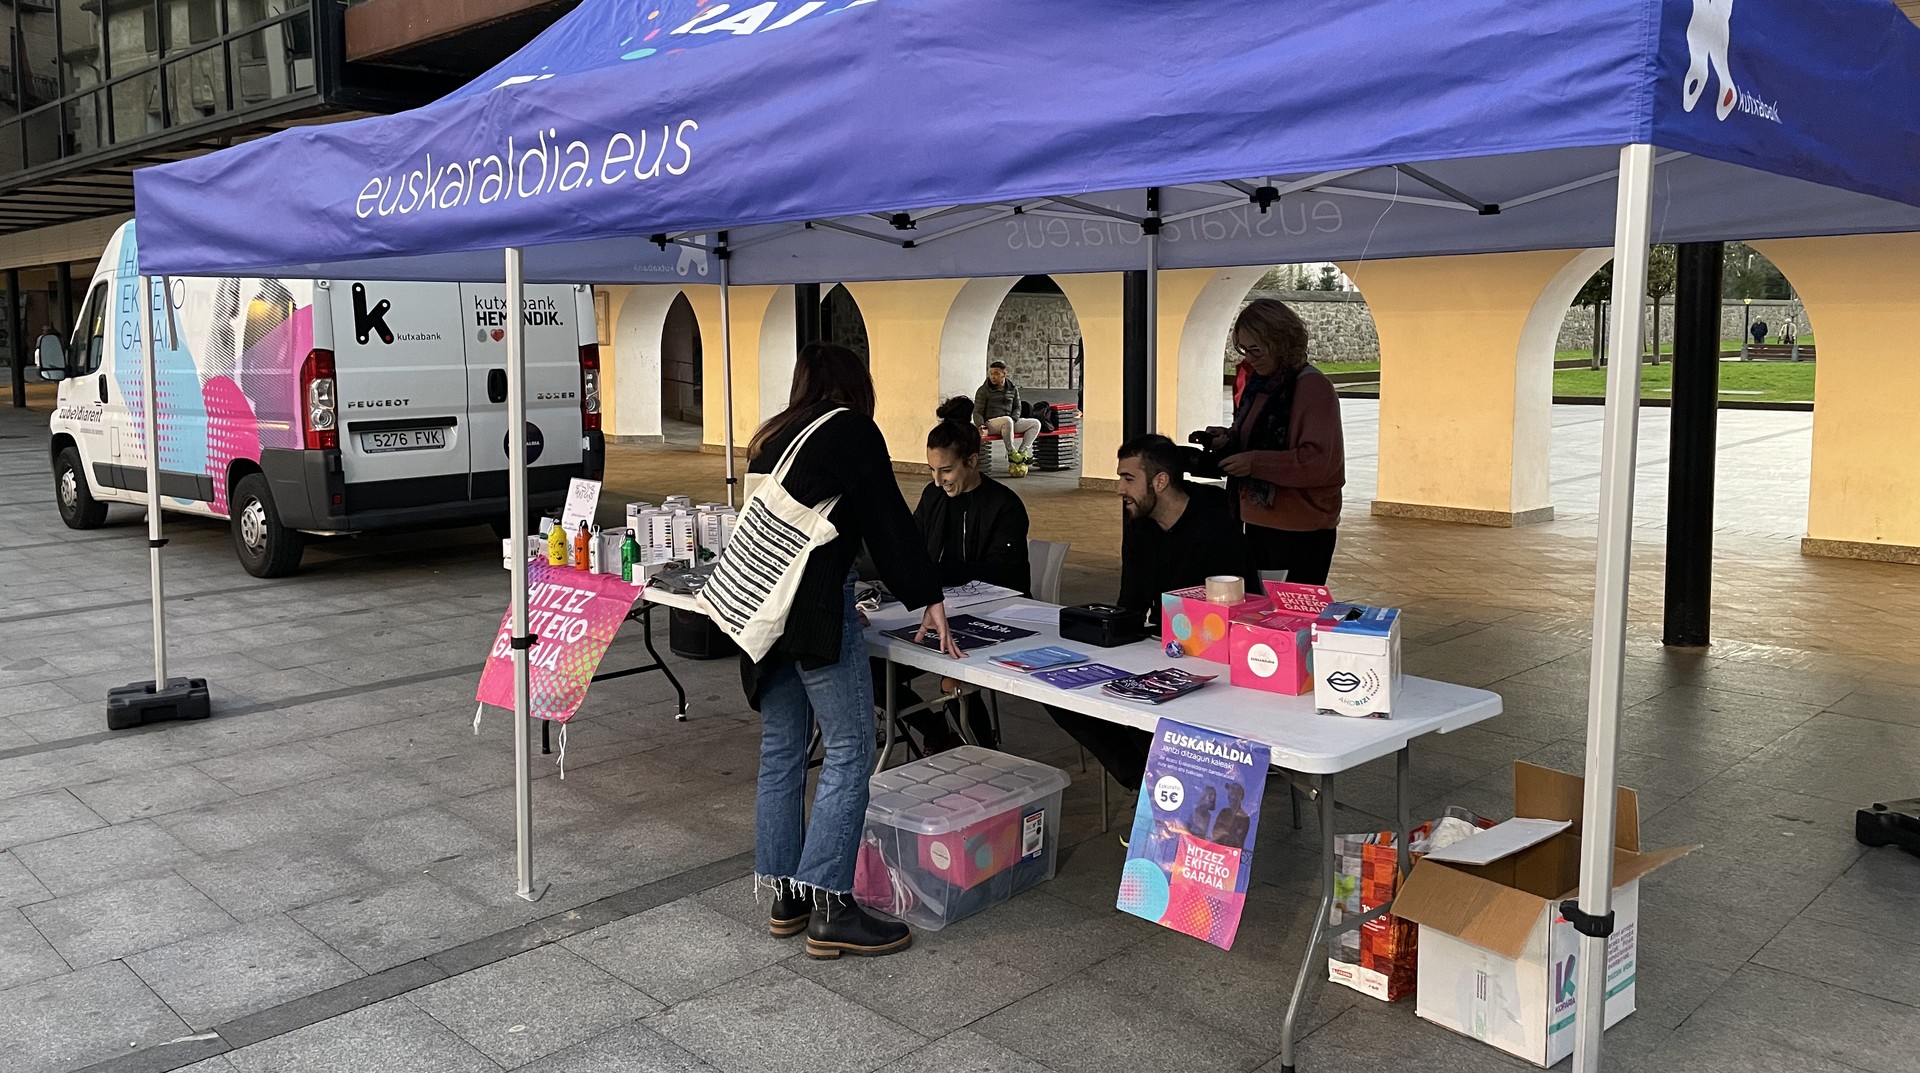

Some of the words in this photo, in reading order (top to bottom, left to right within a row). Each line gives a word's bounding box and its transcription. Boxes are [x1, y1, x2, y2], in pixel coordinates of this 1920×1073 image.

[355, 118, 699, 219] euskaraldia.eus
[474, 295, 556, 310] kutxank
[476, 311, 564, 326] HEMNDIK.
[397, 332, 442, 341] kutxabank
[347, 399, 410, 409] PEUGEOT
[373, 433, 408, 448] 5276
[415, 430, 440, 445] FVK
[708, 516, 718, 545] MENTO
[528, 582, 597, 614] HITZEZ
[1277, 590, 1318, 602] HITZEZ
[493, 633, 562, 671] GAAIA
[1338, 696, 1371, 706] AHOBIZI
[1163, 731, 1254, 767] EUSKARALDIA
[1180, 750, 1210, 763] ditzagun
[1160, 790, 1178, 803] 5€
[1187, 844, 1226, 866] HITZEZ
[1184, 855, 1230, 879] EKITEKO
[1182, 867, 1224, 890] GARAIA
